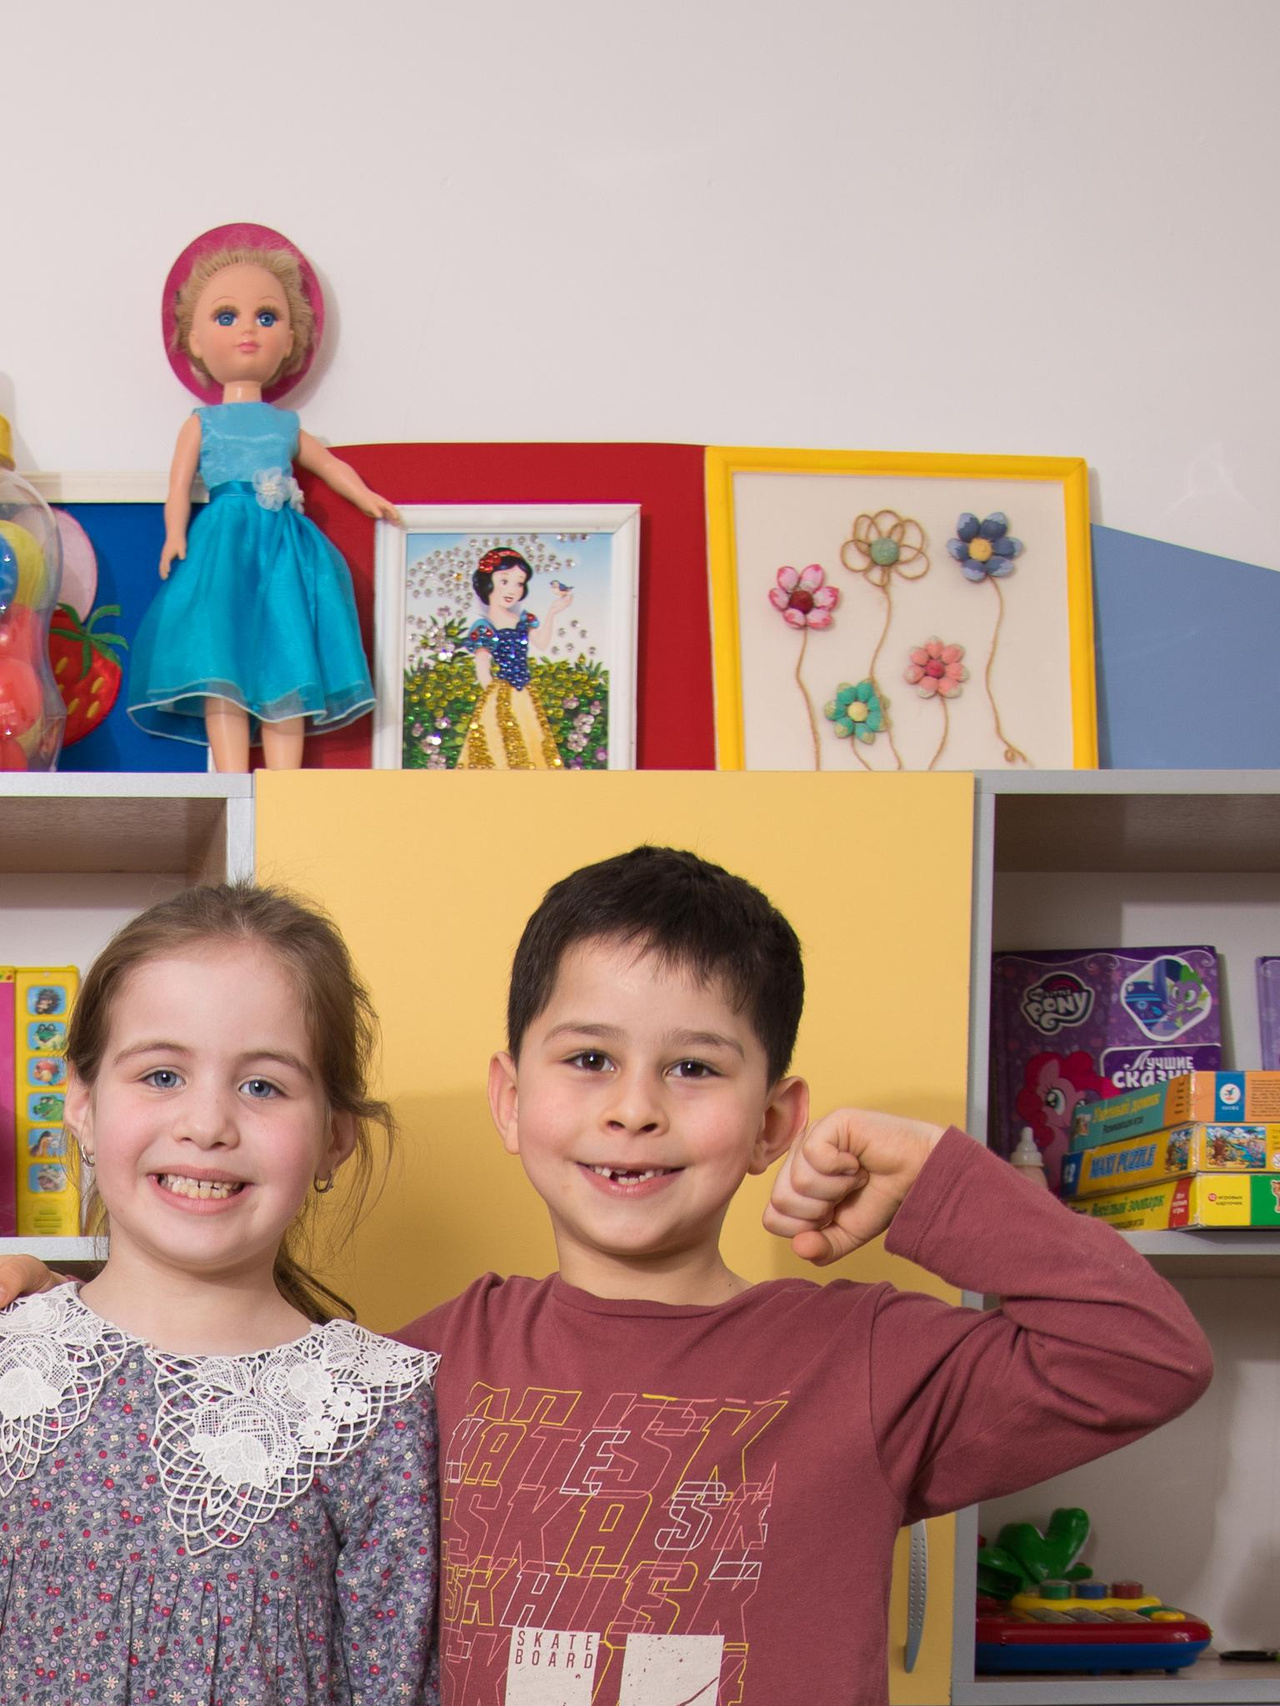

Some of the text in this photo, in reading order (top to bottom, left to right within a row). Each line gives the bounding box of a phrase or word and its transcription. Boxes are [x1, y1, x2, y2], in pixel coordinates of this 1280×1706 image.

[1026, 991, 1088, 1029] PONY
[1123, 1050, 1194, 1071] ЛУЧШИЕ
[516, 1631, 593, 1650] SKATE
[515, 1649, 594, 1669] BOARD
